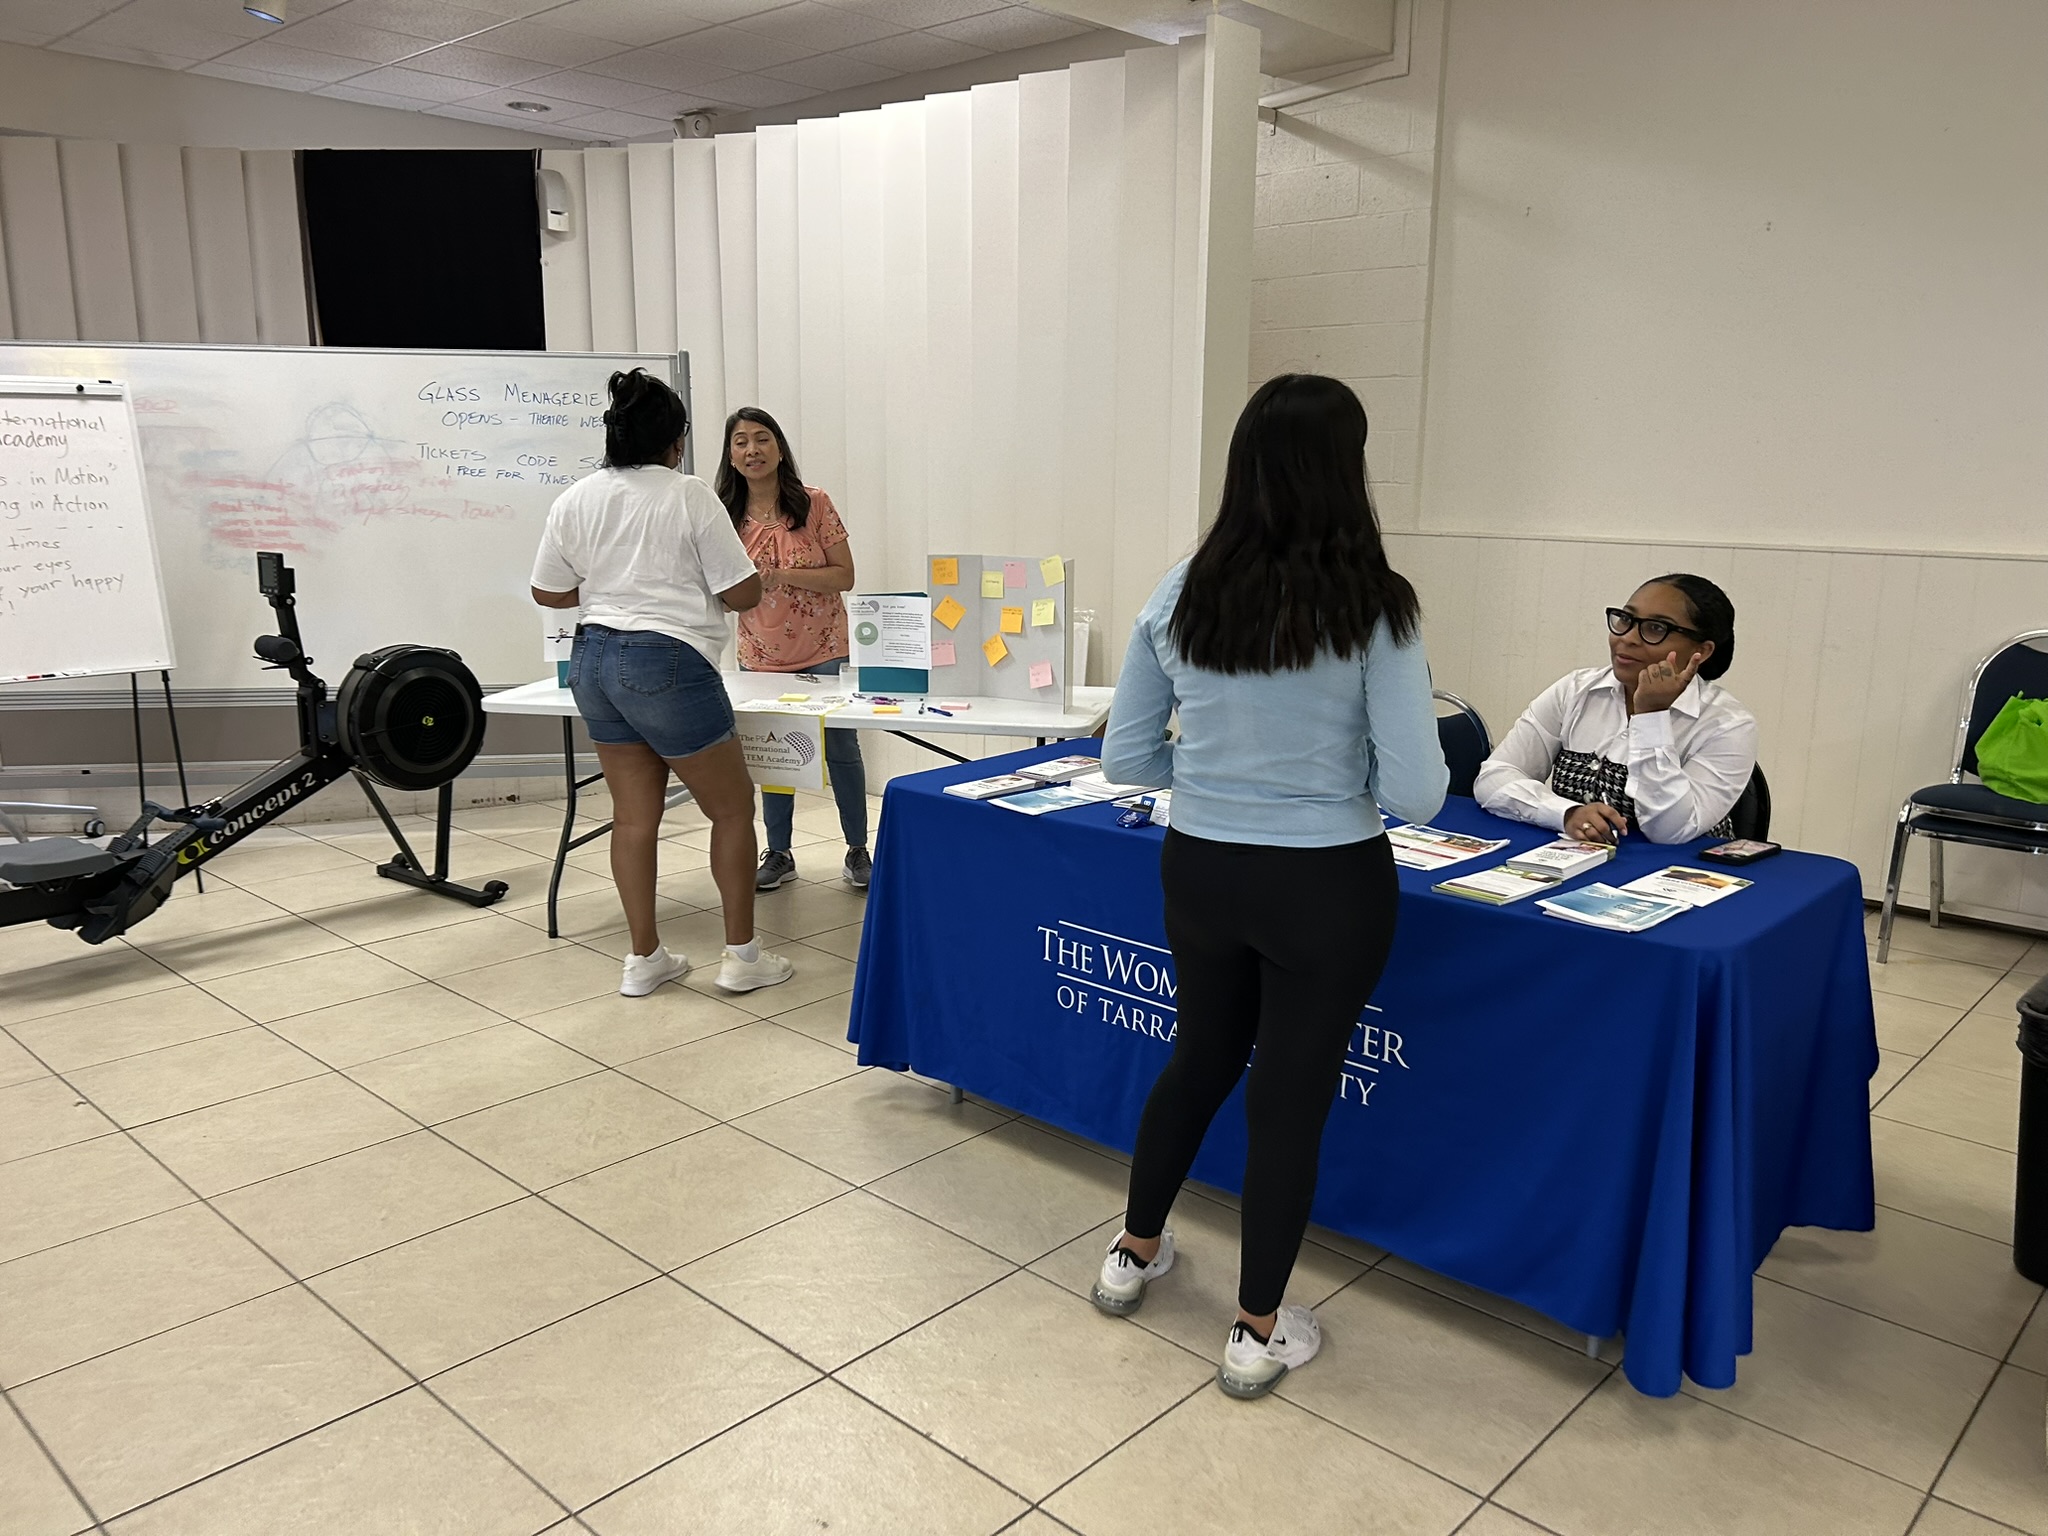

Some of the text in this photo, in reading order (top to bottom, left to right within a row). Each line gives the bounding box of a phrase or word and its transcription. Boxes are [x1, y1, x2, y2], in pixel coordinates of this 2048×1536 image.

[418, 381, 604, 407] GLASS MENAGERIE
[441, 411, 503, 430] OPENS
[529, 412, 569, 427] THEATRE
[0, 430, 68, 459] cademy
[416, 442, 487, 461] TICKETS
[516, 453, 558, 467] CODE
[457, 466, 487, 477] FREE
[496, 469, 525, 480] FOR
[53, 494, 109, 512] Action
[8, 535, 60, 551] times
[33, 560, 72, 574] eyes
[18, 574, 124, 598] your happy
[766, 755, 801, 766] Academy
[210, 782, 301, 845] concept
[1057, 985, 1088, 1015] OF
